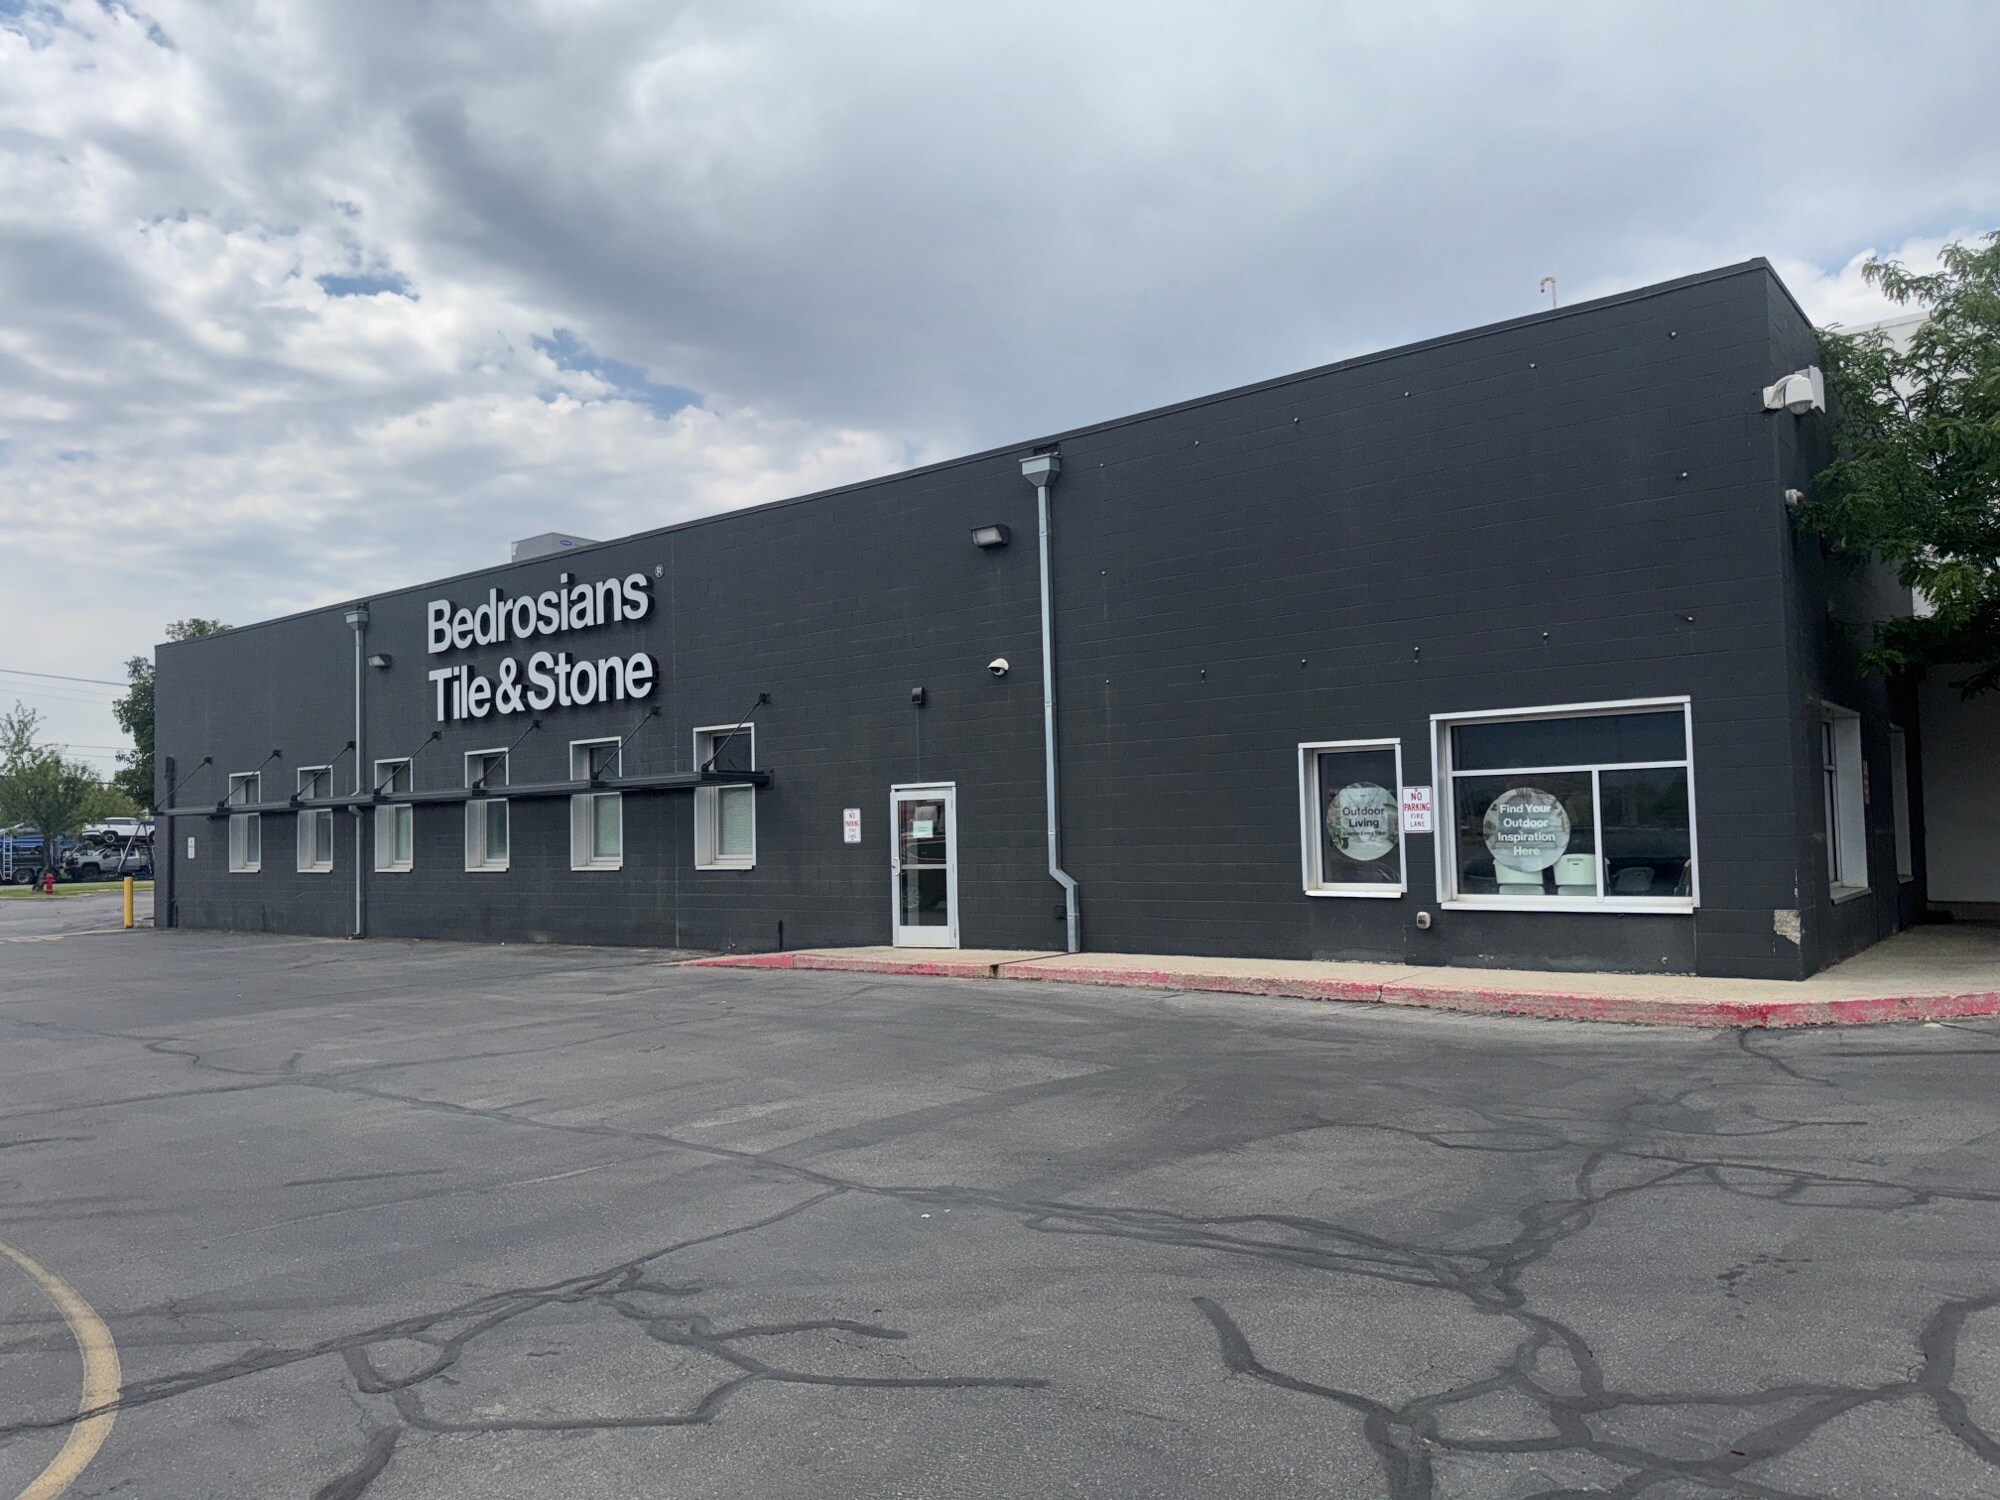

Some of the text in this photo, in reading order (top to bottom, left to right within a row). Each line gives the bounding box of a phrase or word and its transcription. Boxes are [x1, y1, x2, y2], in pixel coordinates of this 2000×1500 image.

[428, 572, 649, 654] Bedrosians
[1410, 792, 1423, 801] NO
[1342, 806, 1385, 816] Outdoor
[1403, 803, 1430, 812] PARKING
[1499, 804, 1552, 814] Find Your
[1348, 817, 1380, 829] Living
[1503, 817, 1549, 828] Outdoor
[1497, 831, 1556, 843] Inspiration
[1513, 845, 1541, 856] Here
